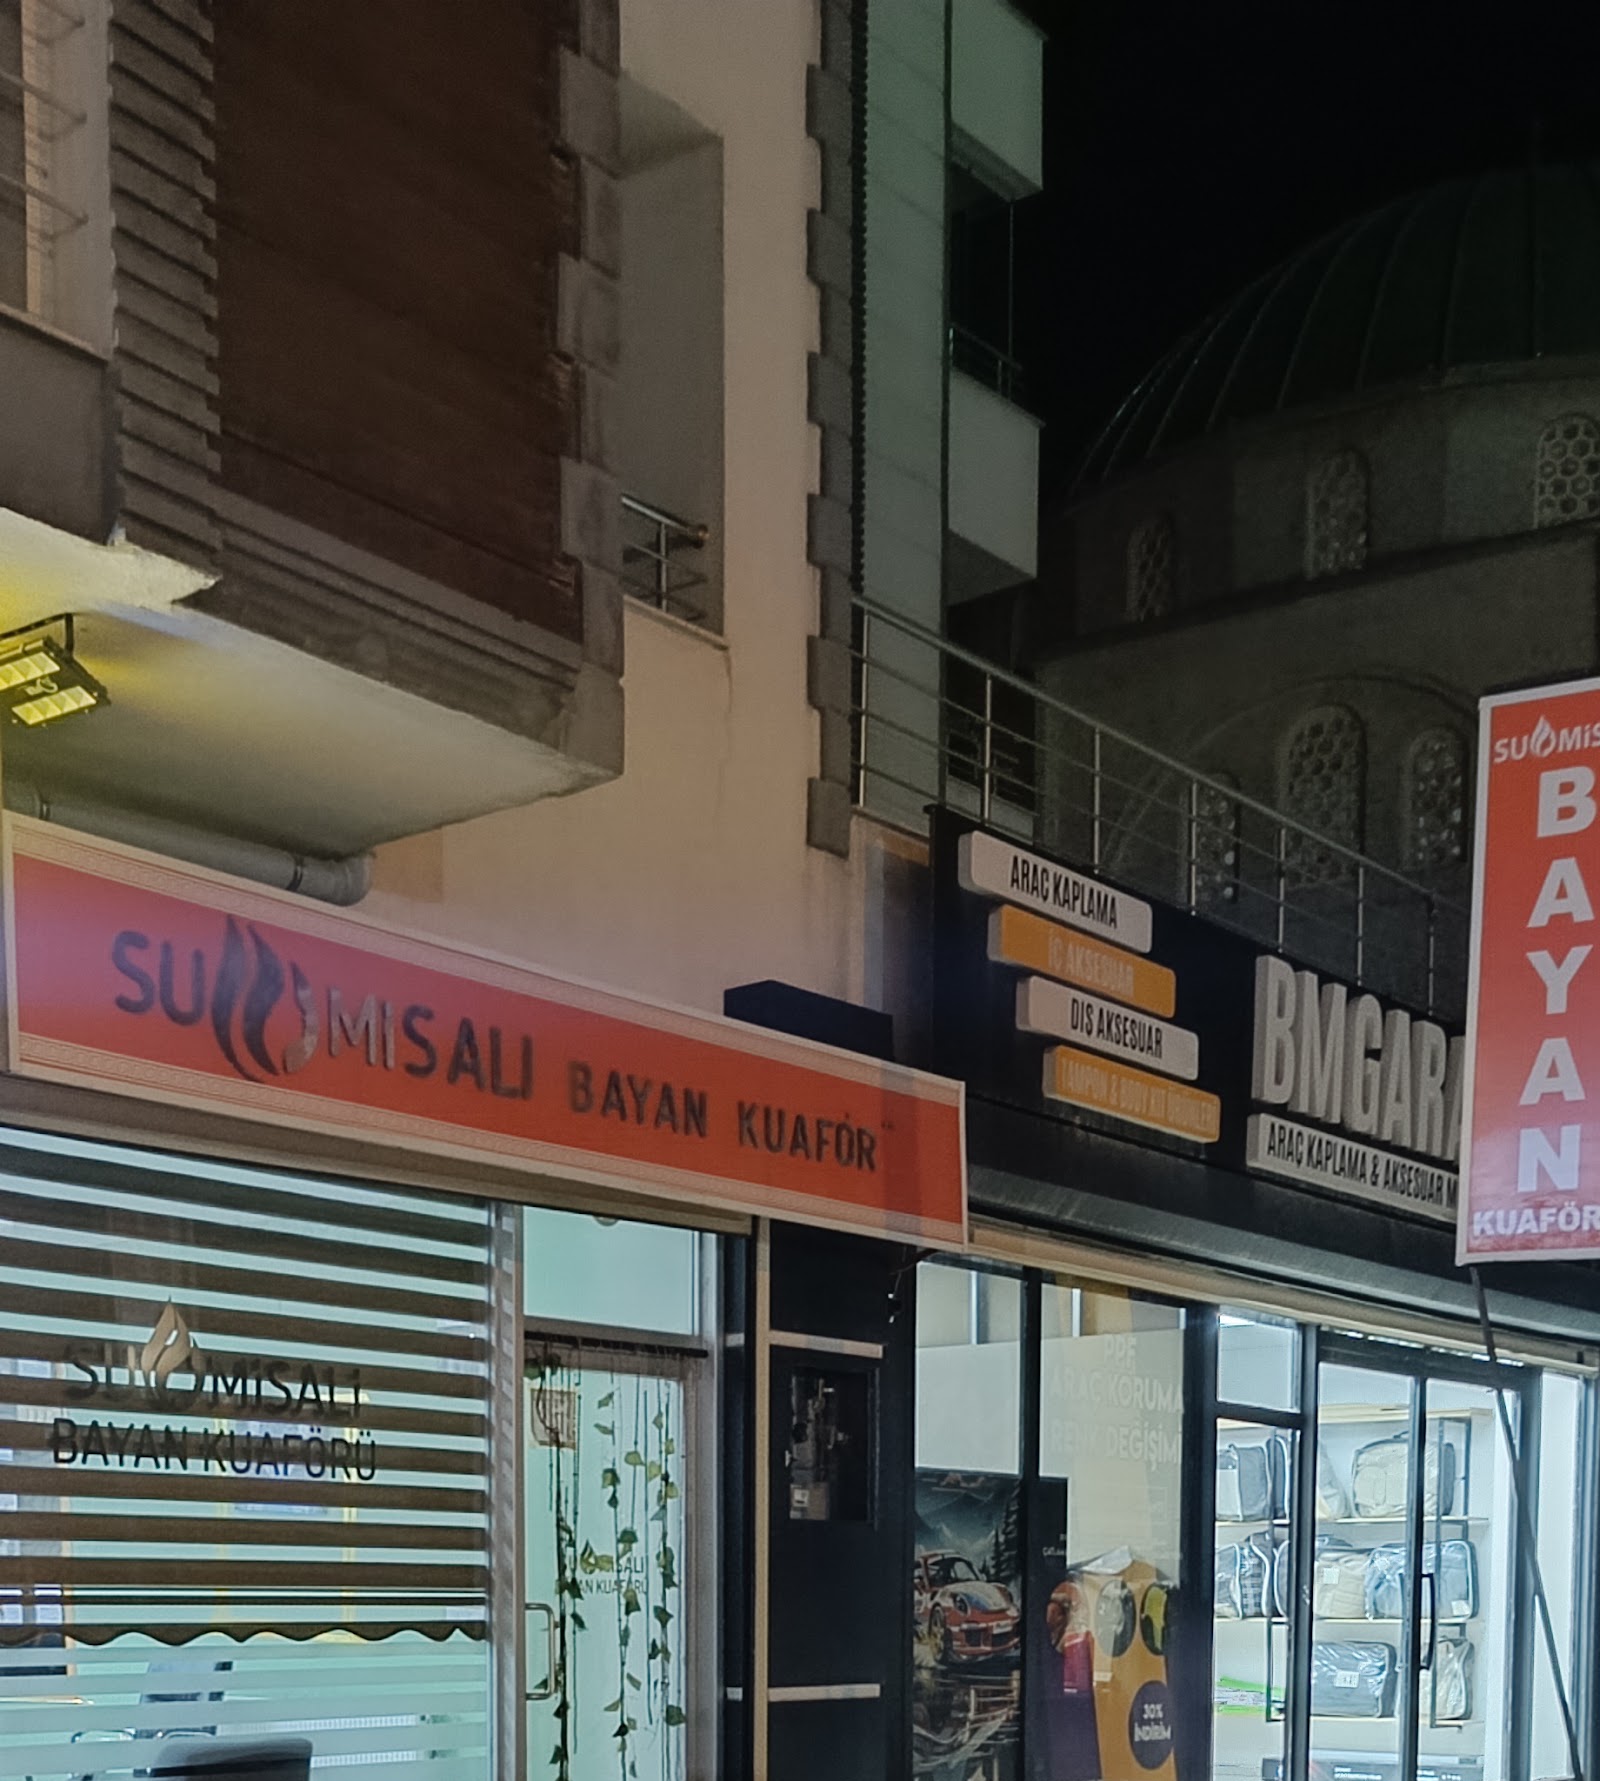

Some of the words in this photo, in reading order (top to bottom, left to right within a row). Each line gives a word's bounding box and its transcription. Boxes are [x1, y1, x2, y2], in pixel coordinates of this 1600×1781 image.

[1053, 871, 1118, 929] KAPLAMA
[1516, 766, 1598, 1193] BAYAN
[1096, 1007, 1163, 1059] AKSESUAR
[568, 1060, 708, 1138] BAYAN
[1267, 1121, 1304, 1168] ARAÇ
[1306, 1133, 1368, 1184] KAPLAMA
[1370, 1154, 1380, 1187] &
[1383, 1158, 1444, 1206] AKSESUAR
[1107, 1372, 1183, 1414] KORUMA
[52, 1417, 188, 1471] BAYAN
[203, 1426, 376, 1481] KUAFÖRÜ
[1142, 1703, 1164, 1720] 30%
